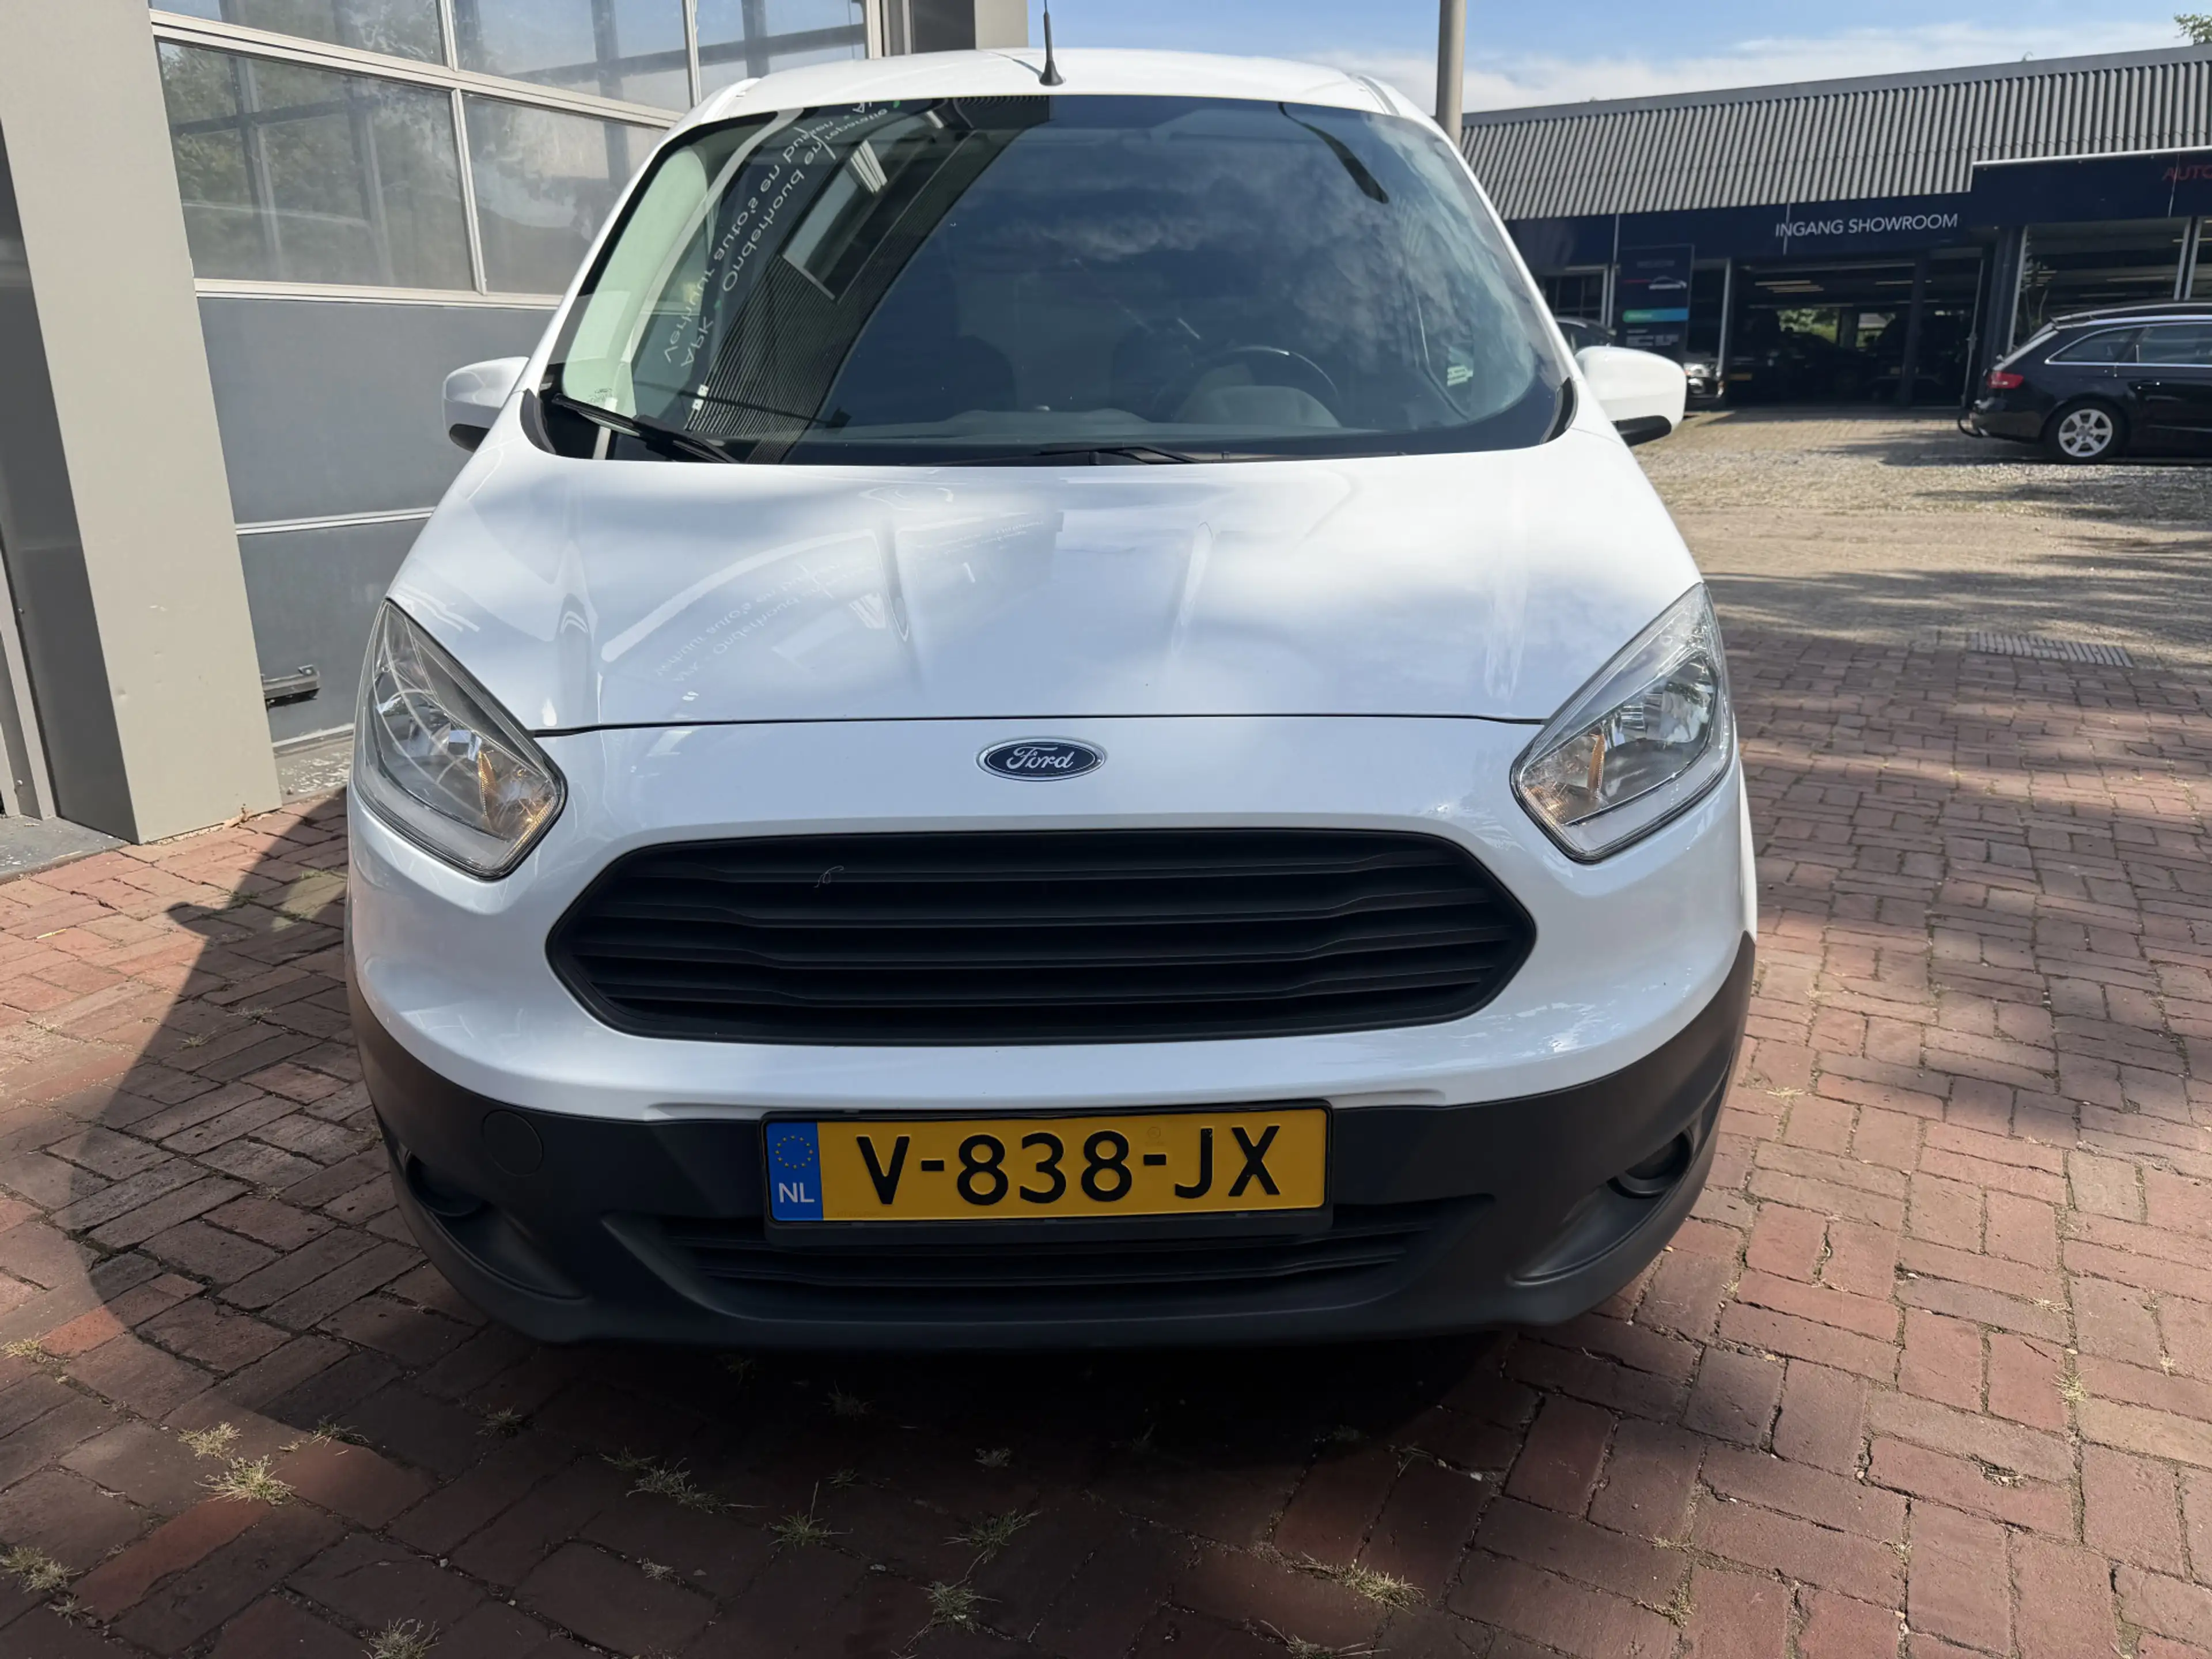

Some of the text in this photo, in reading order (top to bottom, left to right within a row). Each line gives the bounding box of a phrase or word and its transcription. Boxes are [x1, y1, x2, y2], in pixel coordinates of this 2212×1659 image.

[1775, 213, 1958, 237] INGANG SHOWROOM
[1006, 746, 1075, 770] Ford
[856, 1125, 1281, 1206] V-838-JX
[778, 1182, 815, 1203] NL
